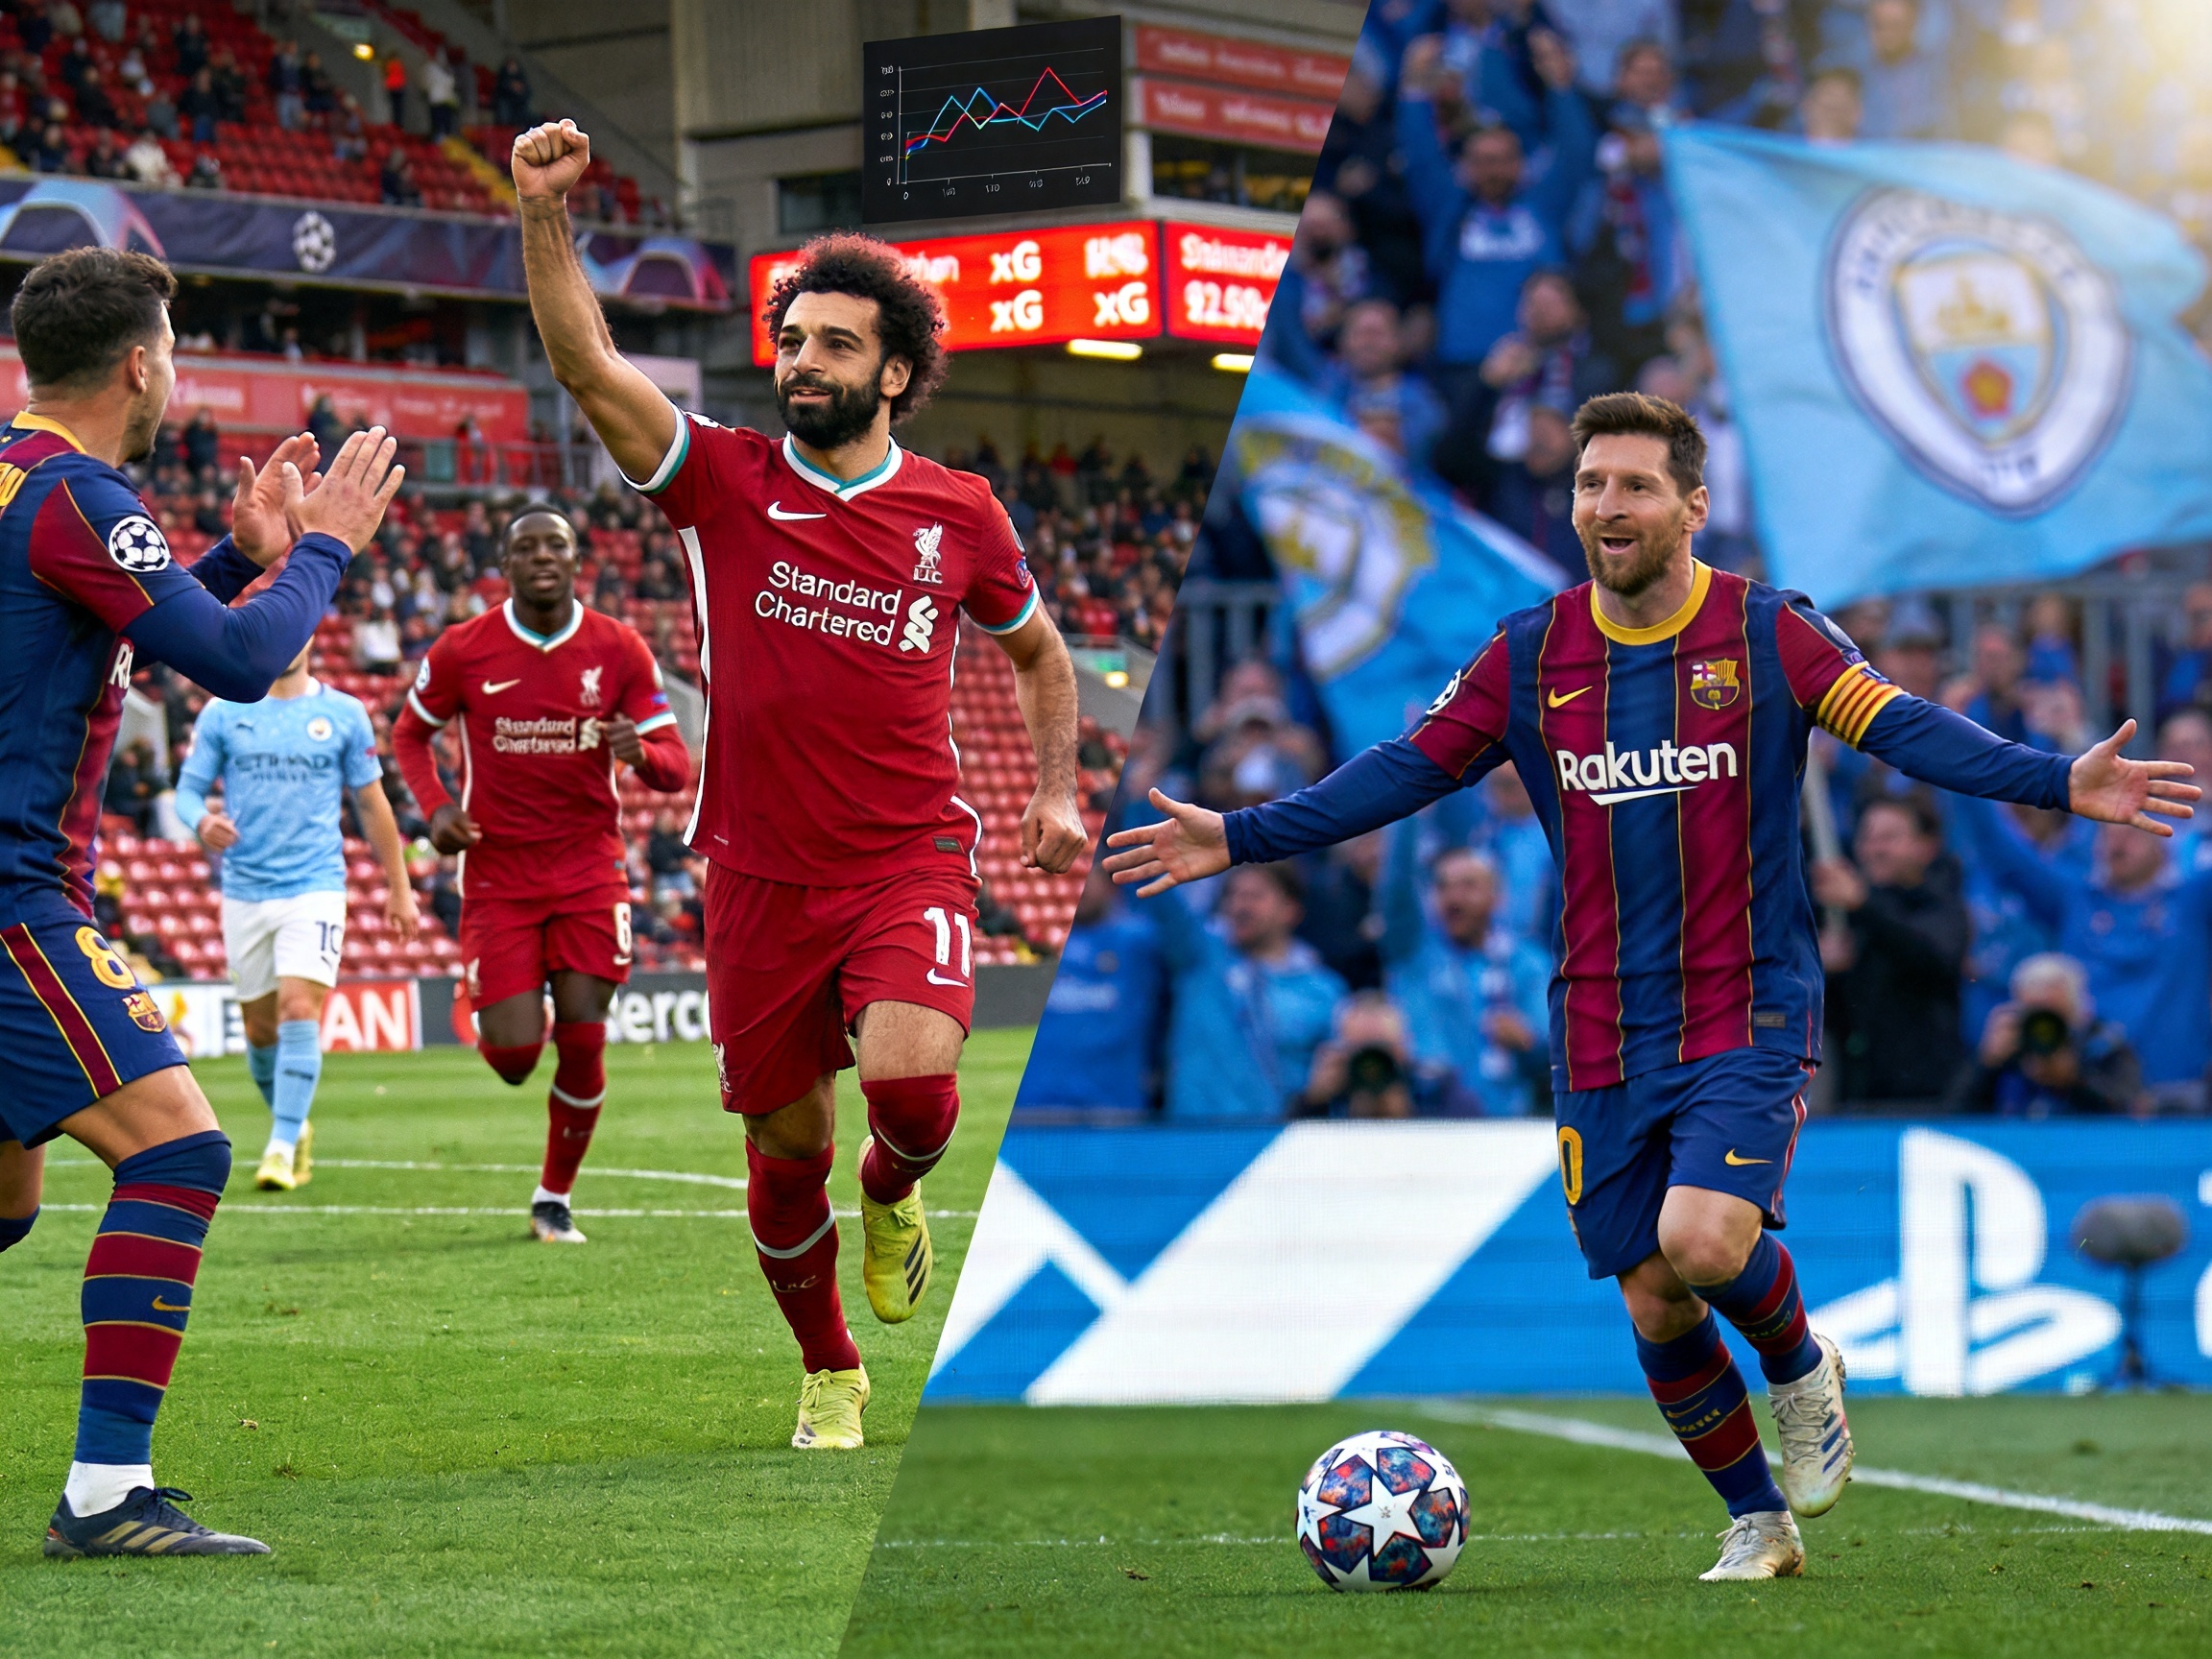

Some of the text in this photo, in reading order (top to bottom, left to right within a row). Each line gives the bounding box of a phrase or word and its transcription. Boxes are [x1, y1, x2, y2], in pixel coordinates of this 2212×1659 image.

[990, 241, 1042, 285] xG
[991, 281, 1150, 333] xG xG
[768, 561, 902, 616] Standard
[755, 589, 896, 646] Chartered
[1555, 739, 1738, 791] Rakuten
[74, 925, 136, 990] 8
[923, 906, 971, 978] 11
